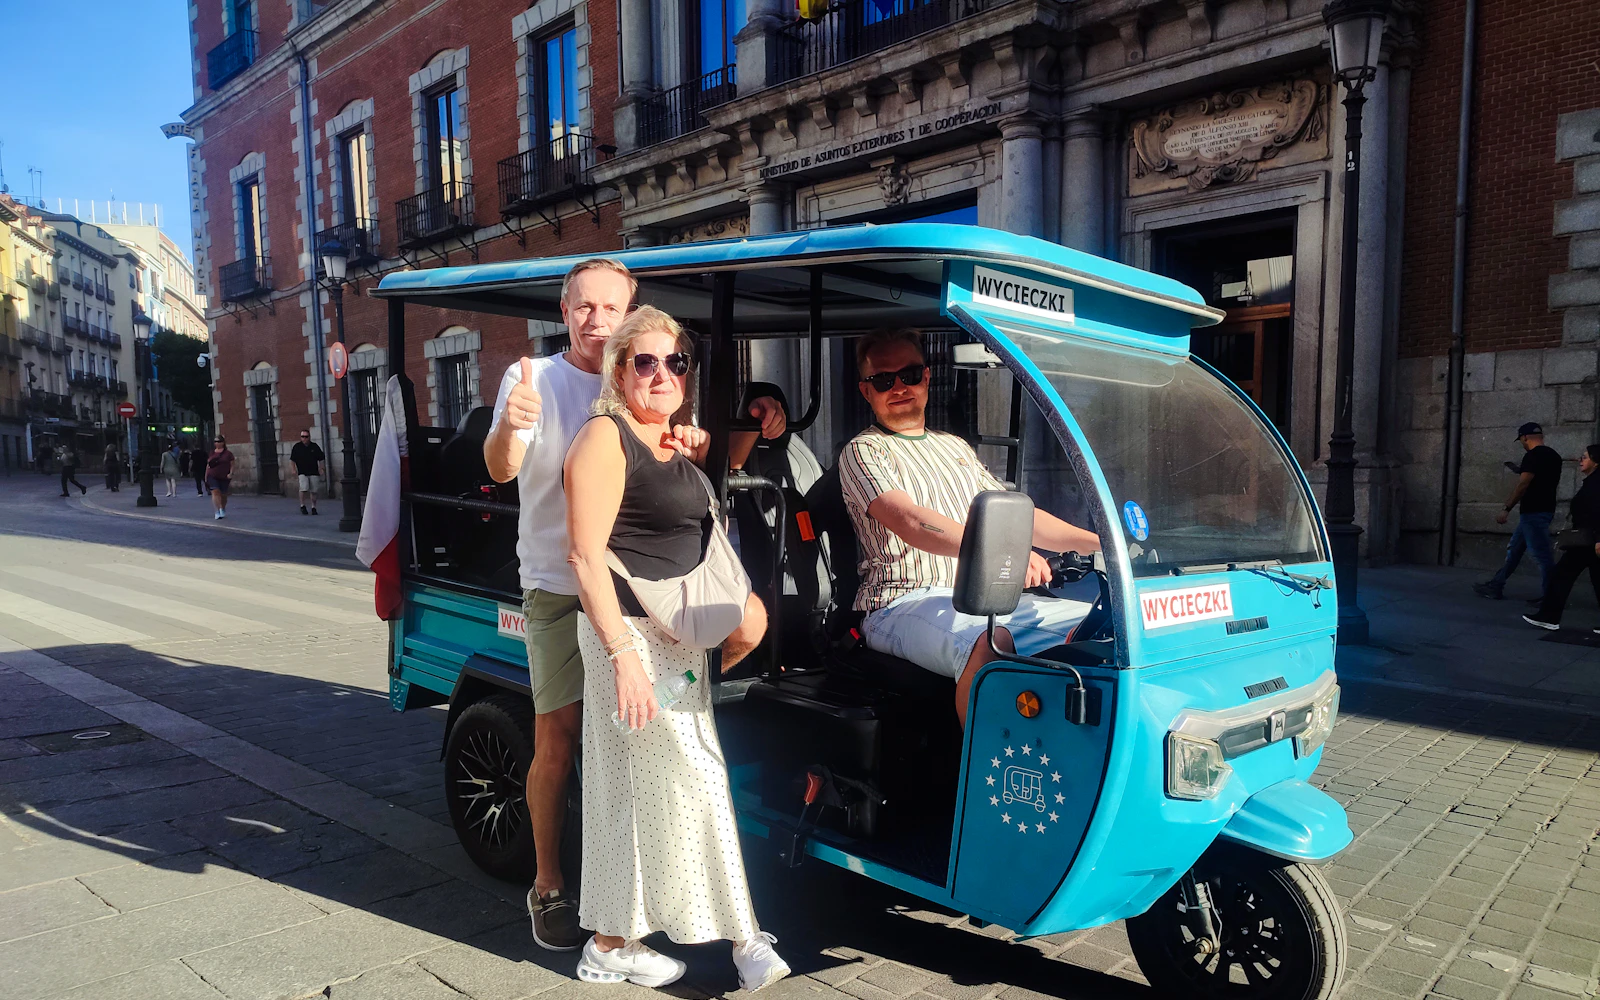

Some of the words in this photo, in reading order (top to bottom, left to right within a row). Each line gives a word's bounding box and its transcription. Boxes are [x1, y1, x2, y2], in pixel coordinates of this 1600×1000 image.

[163, 124, 195, 138] HOTEL
[760, 159, 799, 179] MINISTERIO
[801, 155, 811, 168] DE
[814, 145, 850, 165] ASUNTOS
[853, 131, 905, 154] EXTERIORES
[909, 126, 915, 139] Y
[919, 122, 932, 136] DE
[935, 101, 1001, 131] COOPERACION
[194, 227, 207, 293] MAYOR
[977, 274, 1065, 313] WYCIECZKI
[1143, 589, 1228, 622] WYCIECZKI
